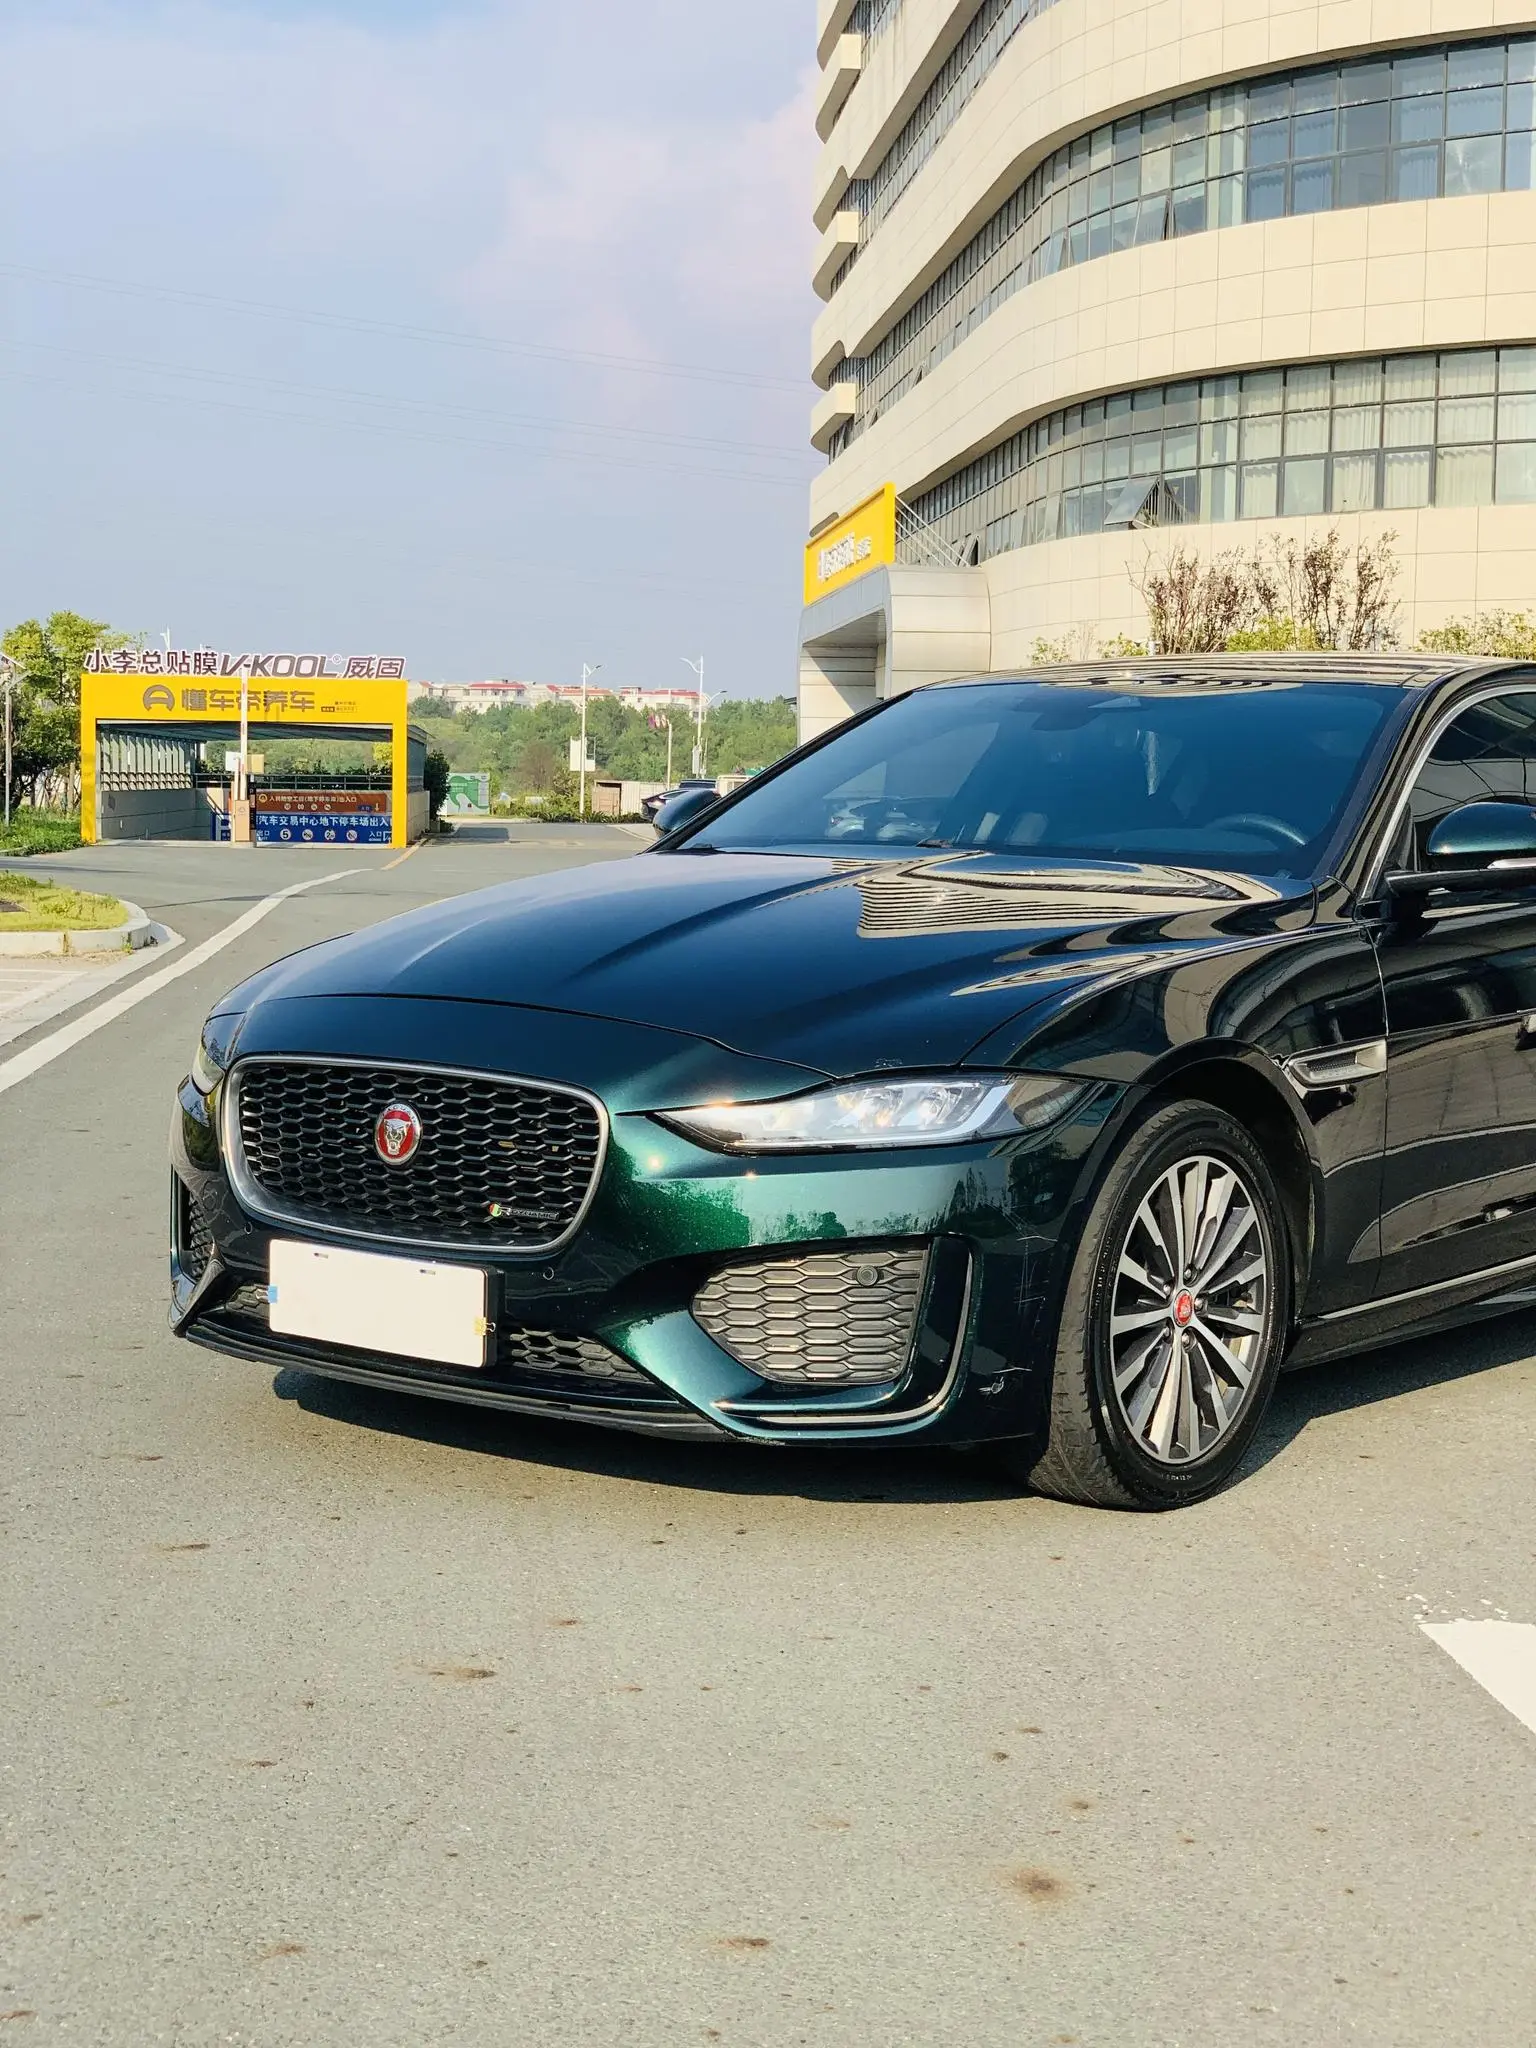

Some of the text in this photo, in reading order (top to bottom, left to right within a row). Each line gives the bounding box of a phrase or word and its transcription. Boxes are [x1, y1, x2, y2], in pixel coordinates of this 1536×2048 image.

[85, 649, 218, 675] 小李总贴膜
[343, 655, 406, 679] 威固
